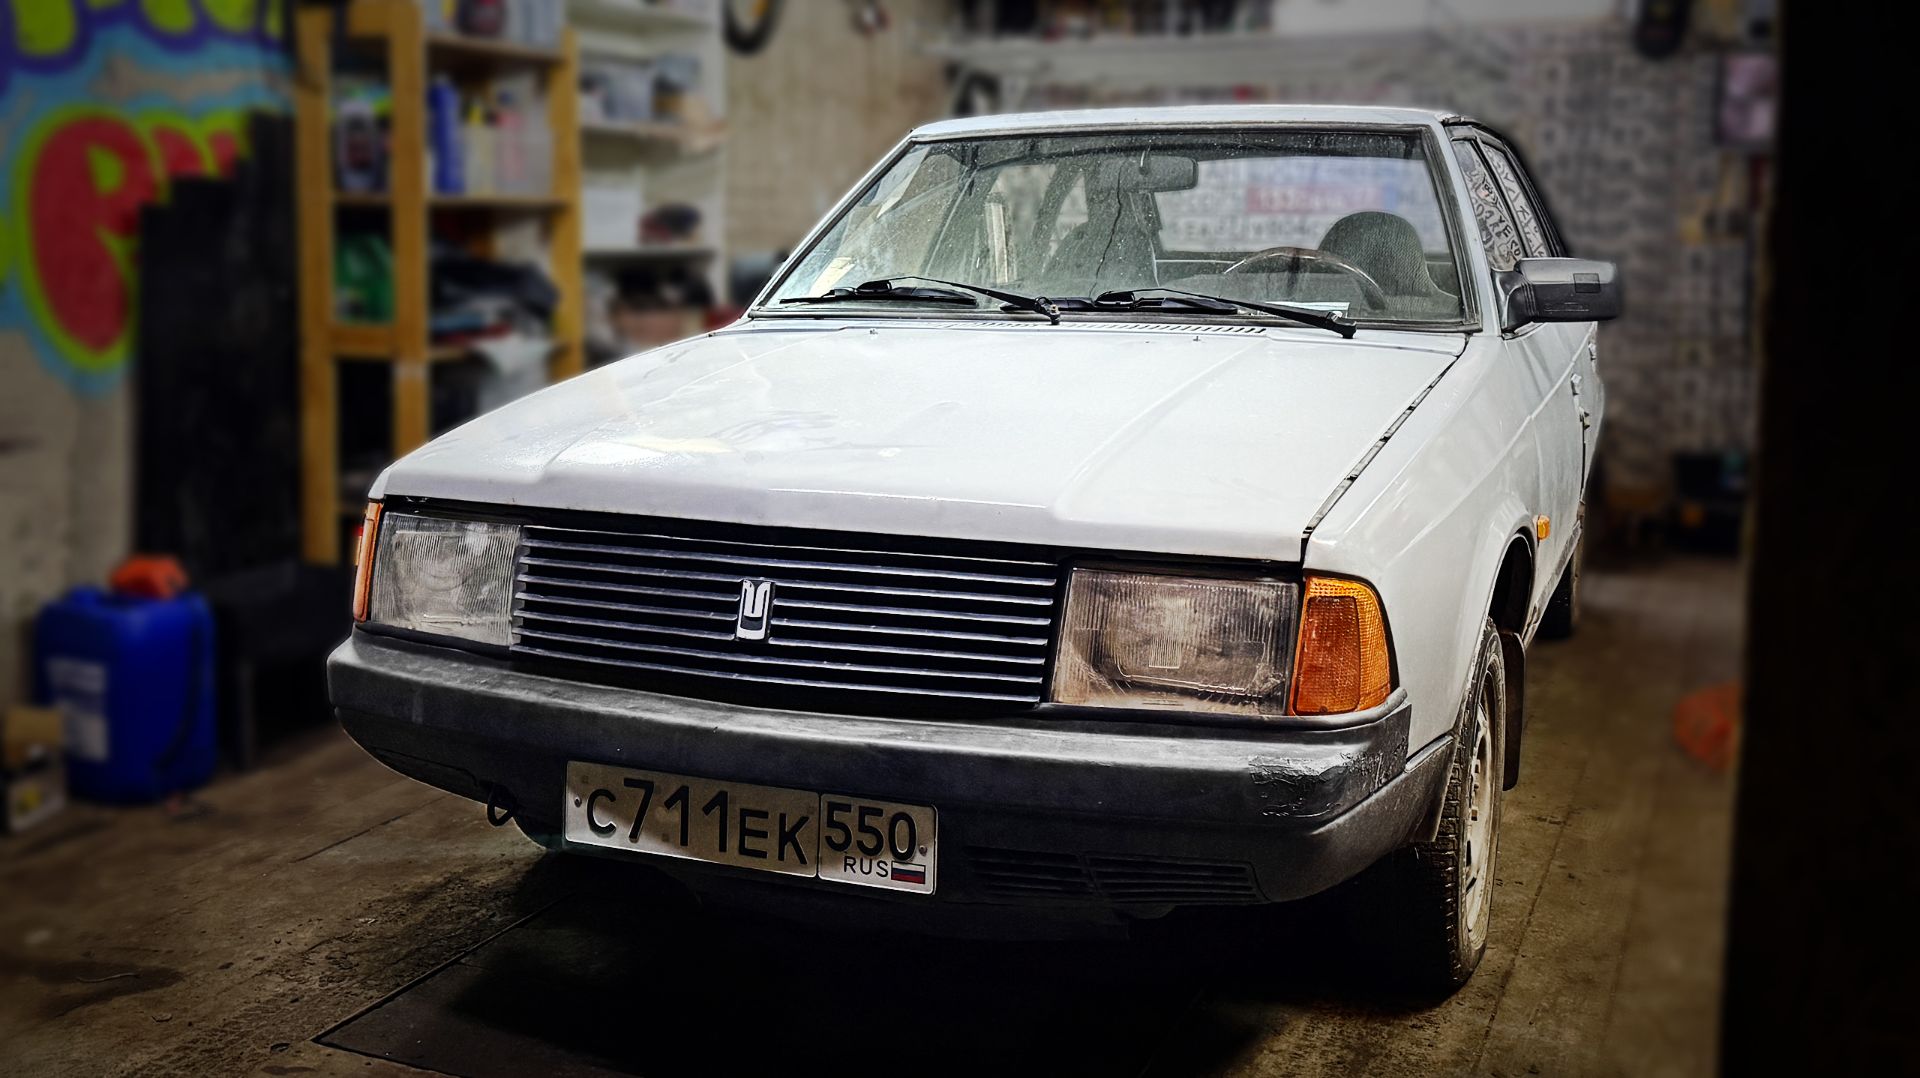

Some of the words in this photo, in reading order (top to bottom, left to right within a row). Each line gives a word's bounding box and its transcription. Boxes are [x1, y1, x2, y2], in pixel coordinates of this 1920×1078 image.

[586, 777, 810, 866] C711EK
[824, 801, 917, 862] 550
[843, 855, 889, 878] RUS
